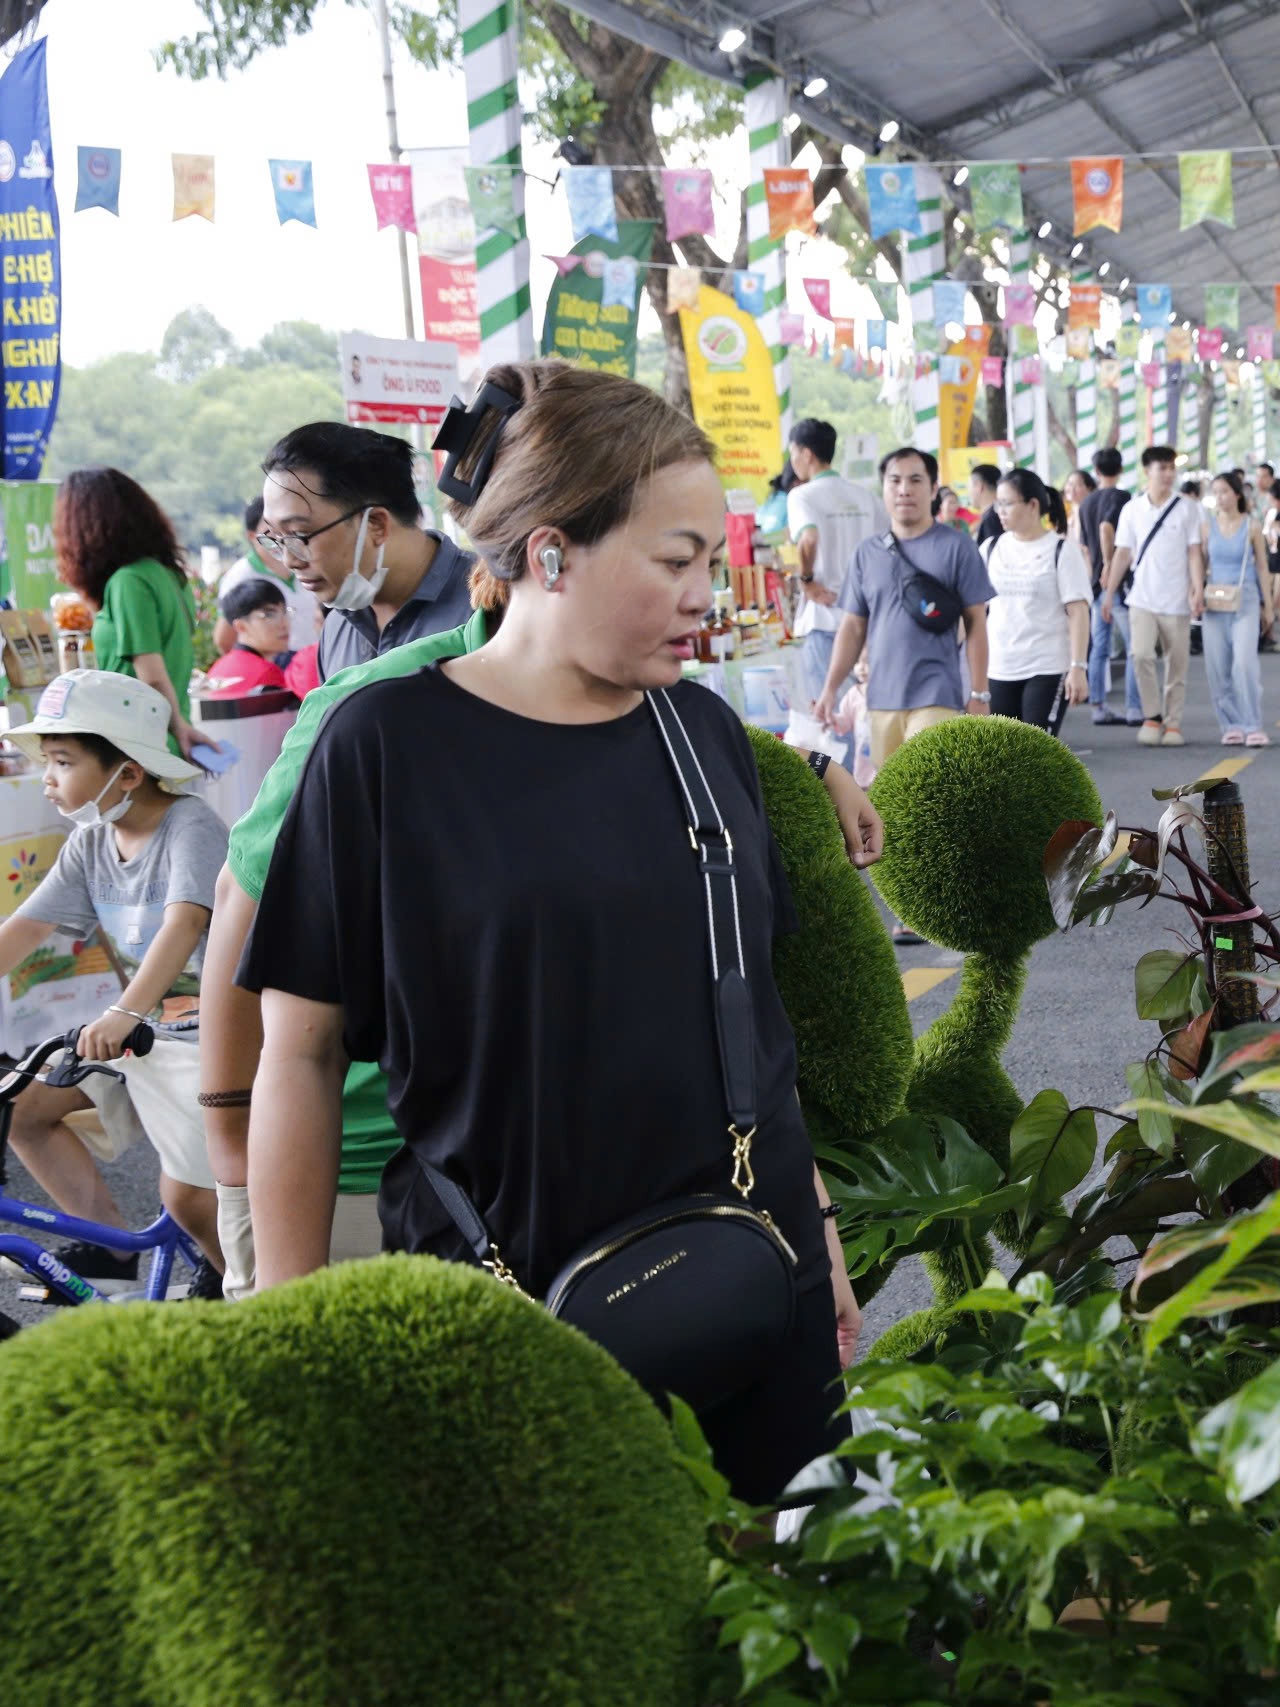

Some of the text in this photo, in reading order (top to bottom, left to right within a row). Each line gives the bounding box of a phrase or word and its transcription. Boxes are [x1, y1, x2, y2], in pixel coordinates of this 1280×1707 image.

[3, 249, 54, 287] CHỢ
[606, 1249, 688, 1303] MARC JACOBS
